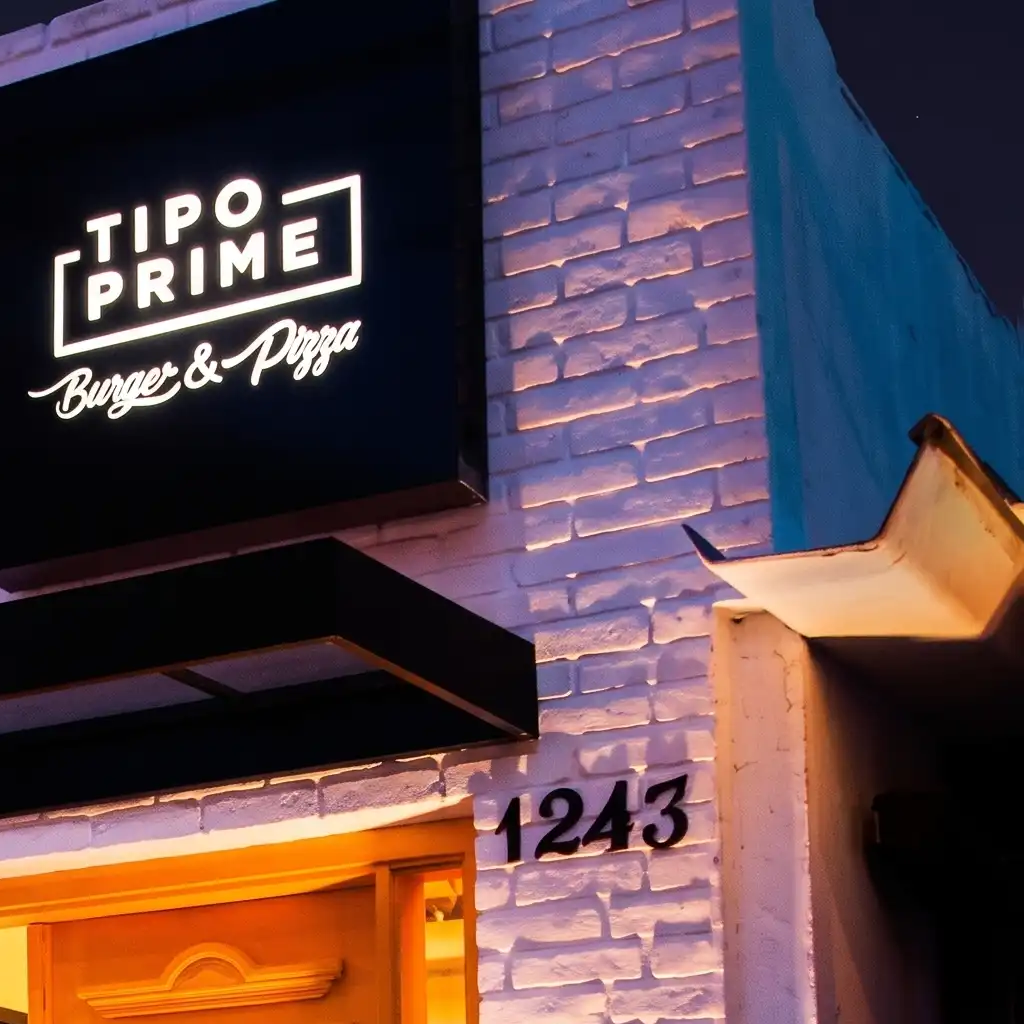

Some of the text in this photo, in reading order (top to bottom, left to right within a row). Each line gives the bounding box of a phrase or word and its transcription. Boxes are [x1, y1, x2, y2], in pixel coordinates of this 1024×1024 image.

[85, 177, 263, 264] TIPO
[86, 216, 320, 322] PRIME
[27, 318, 362, 420] Burger & Pizza
[494, 773, 689, 863] 1243
